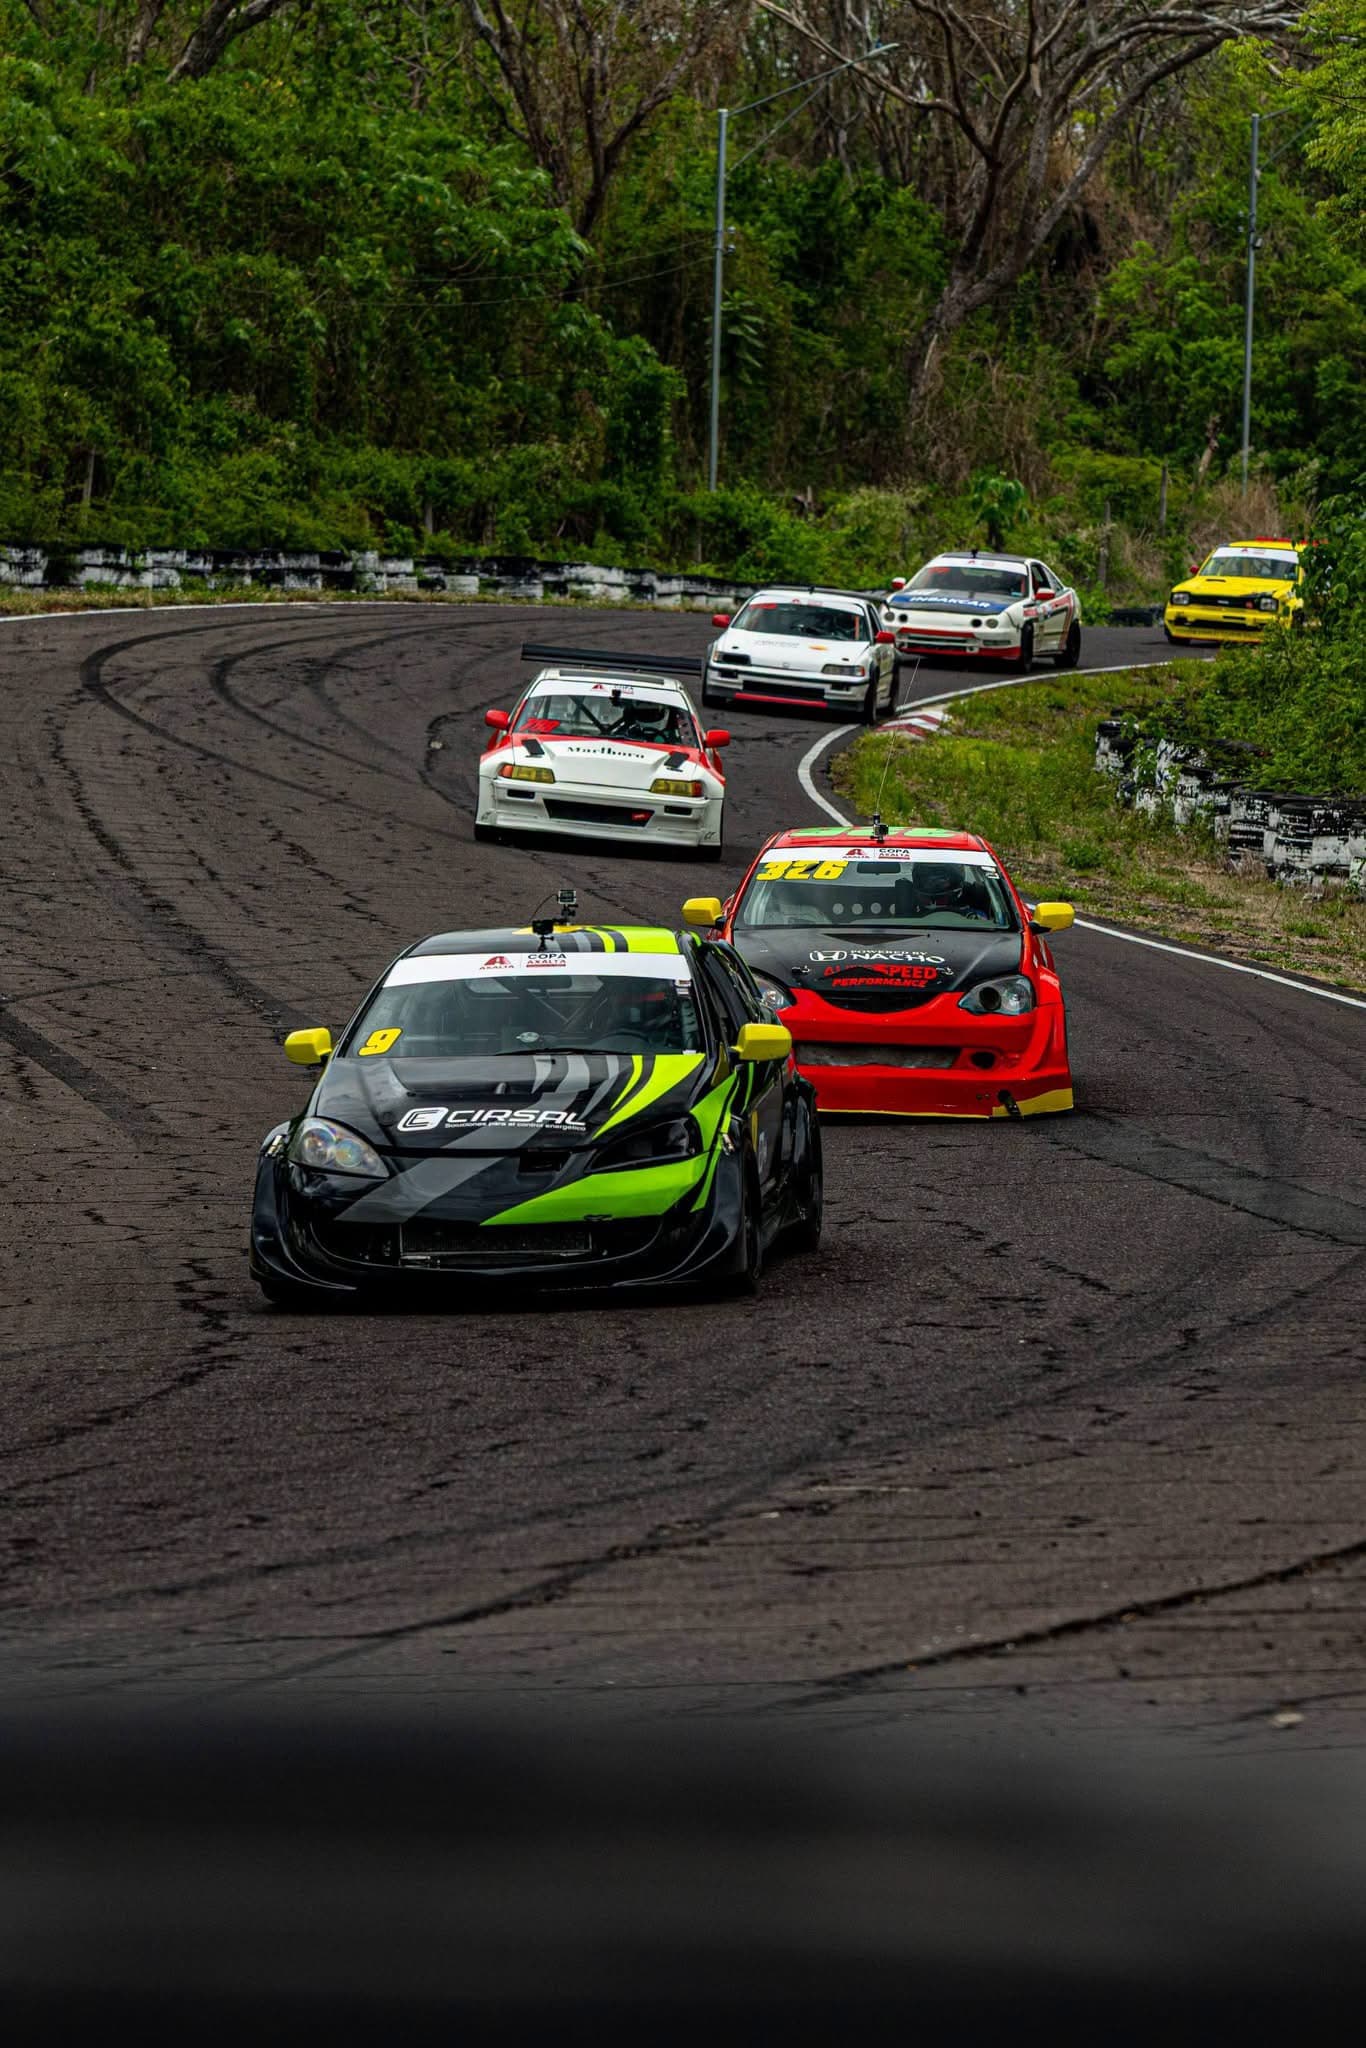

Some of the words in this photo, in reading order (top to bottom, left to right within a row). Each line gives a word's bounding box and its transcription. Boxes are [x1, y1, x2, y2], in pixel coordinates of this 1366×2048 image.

[567, 746, 645, 759] Marlboro
[756, 860, 849, 880] 326
[849, 953, 945, 964] NACHO
[832, 977, 929, 988] PERFORMANCE
[358, 1027, 403, 1056] 9
[446, 1109, 586, 1126] CIRSAL
